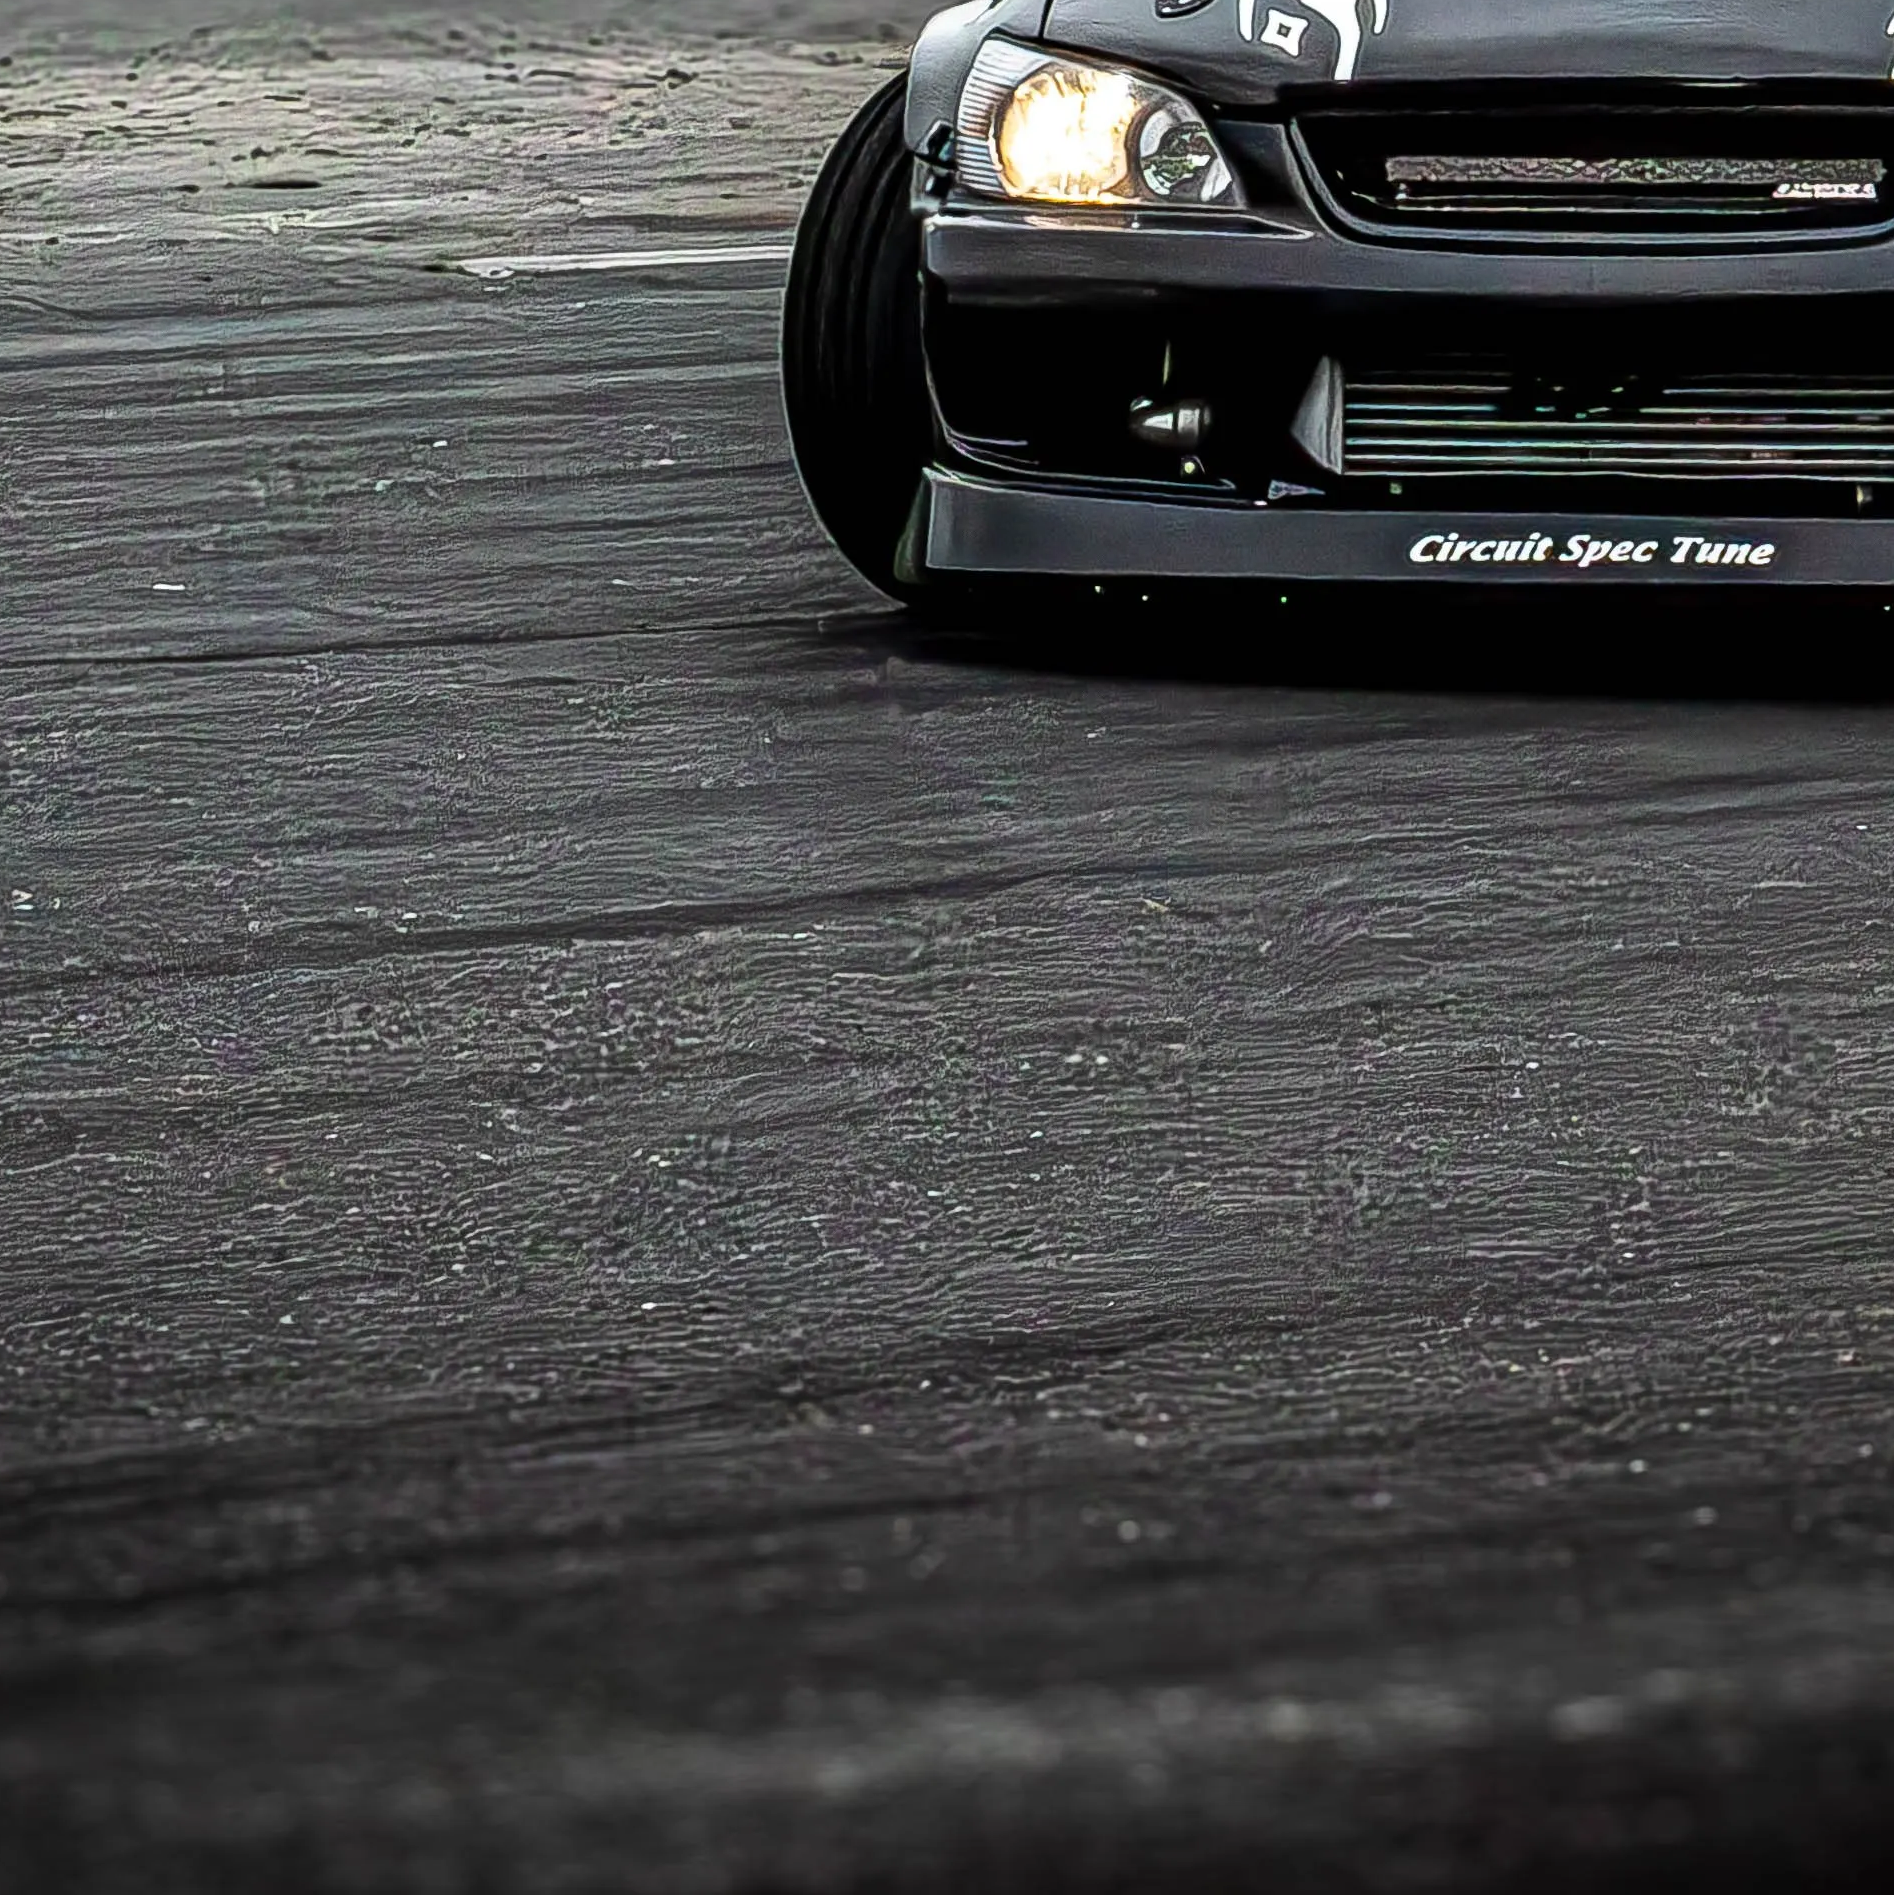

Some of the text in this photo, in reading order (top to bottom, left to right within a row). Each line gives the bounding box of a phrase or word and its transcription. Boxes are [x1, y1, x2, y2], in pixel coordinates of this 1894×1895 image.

[1408, 531, 1776, 569] Circuit Spec Tune
